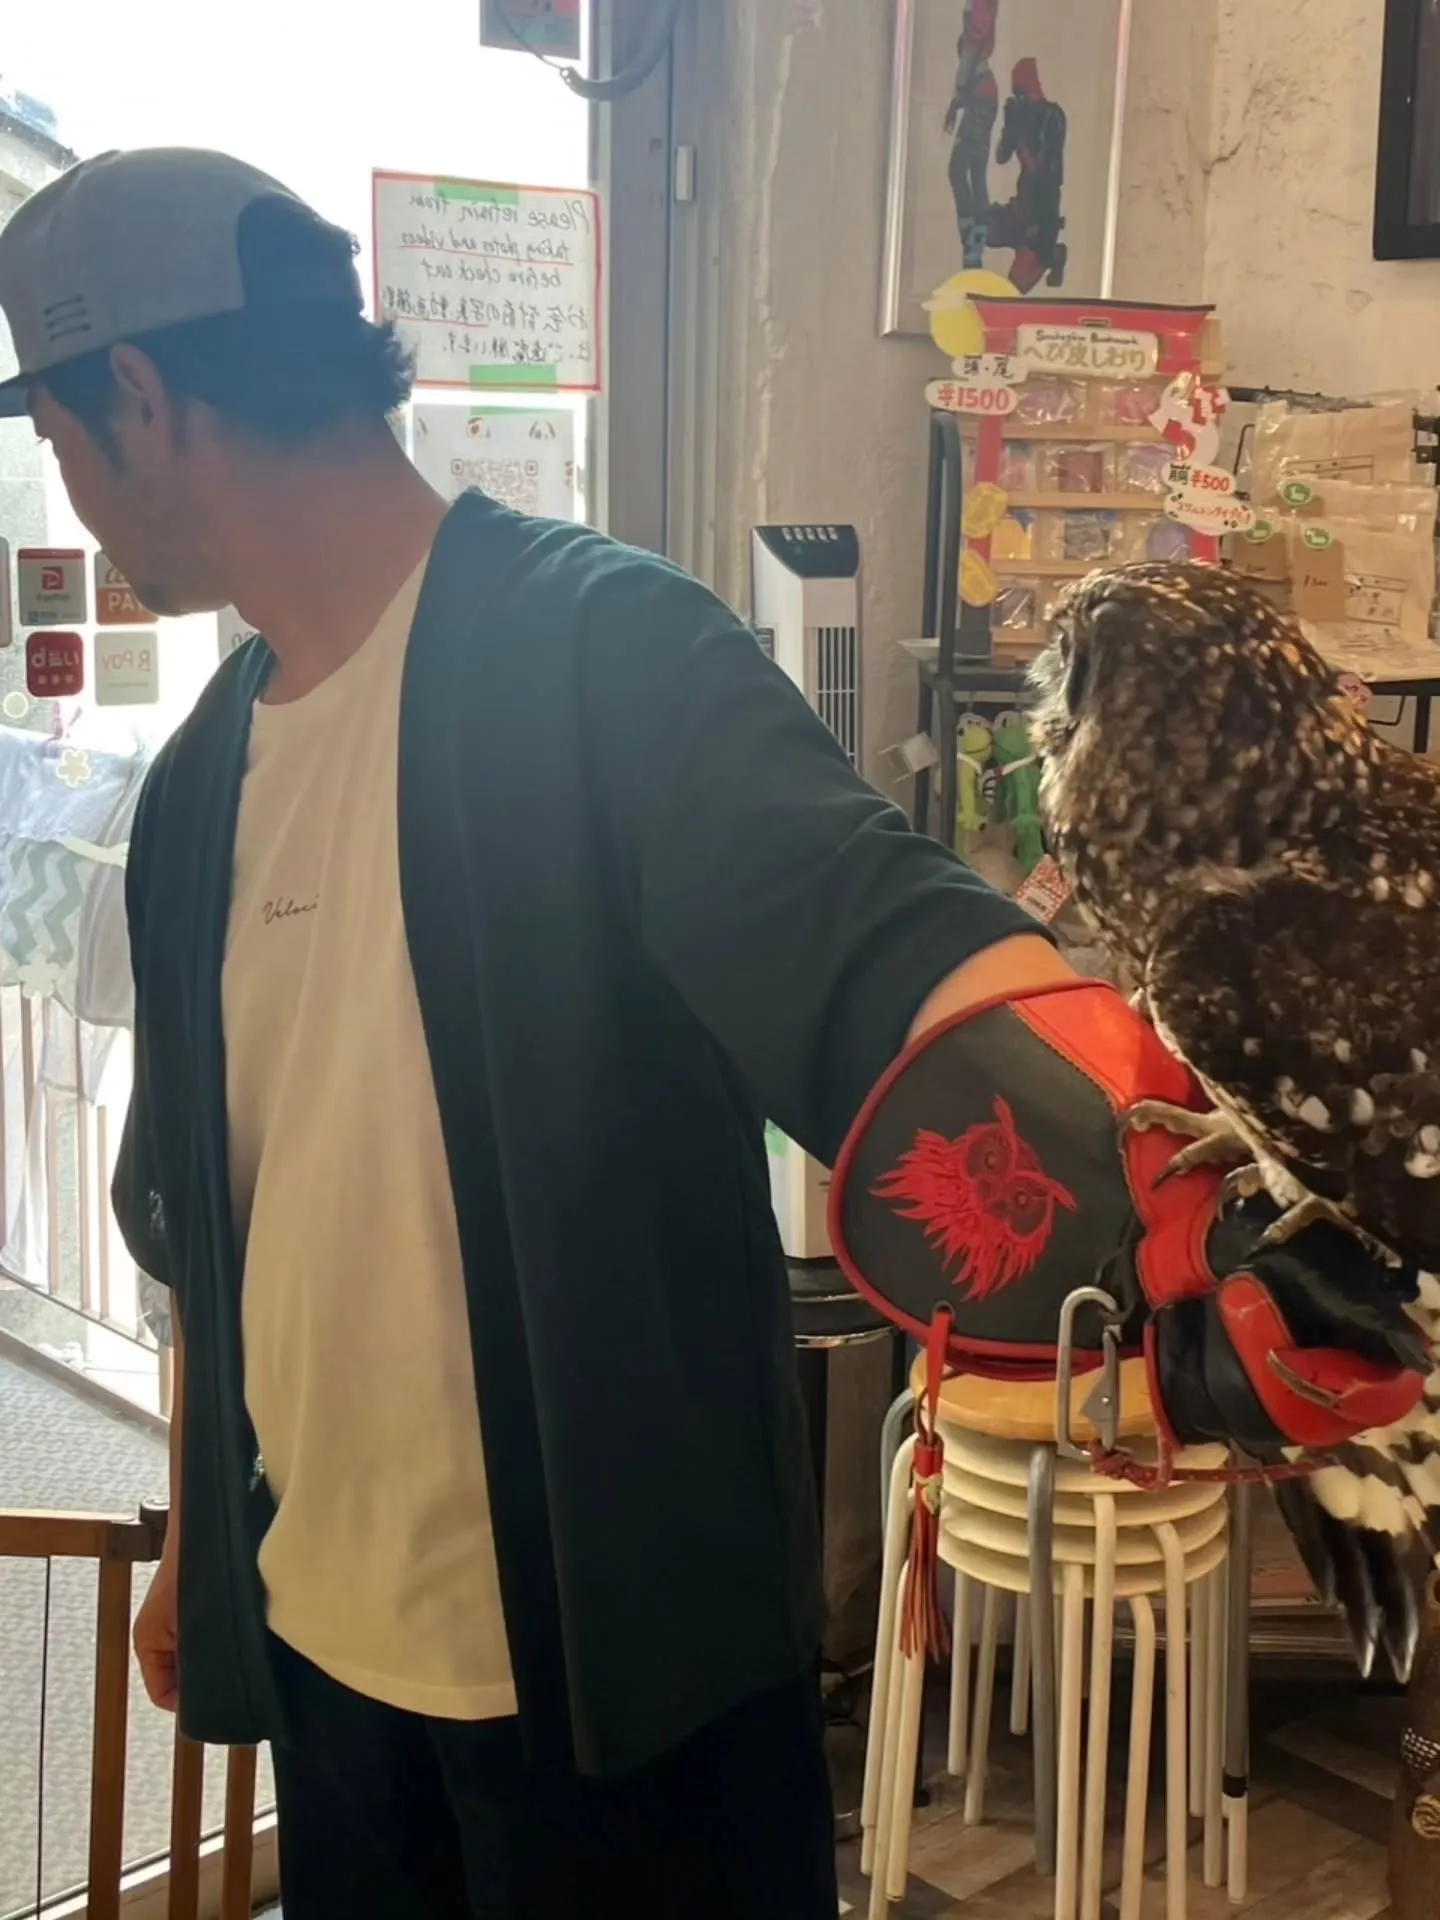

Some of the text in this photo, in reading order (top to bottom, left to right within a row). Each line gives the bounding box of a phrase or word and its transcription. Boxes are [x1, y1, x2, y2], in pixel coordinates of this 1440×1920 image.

[1023, 344, 1147, 371] へび皮しおり
[937, 384, 1010, 411] ¥1500
[1190, 470, 1231, 492] ¥500
